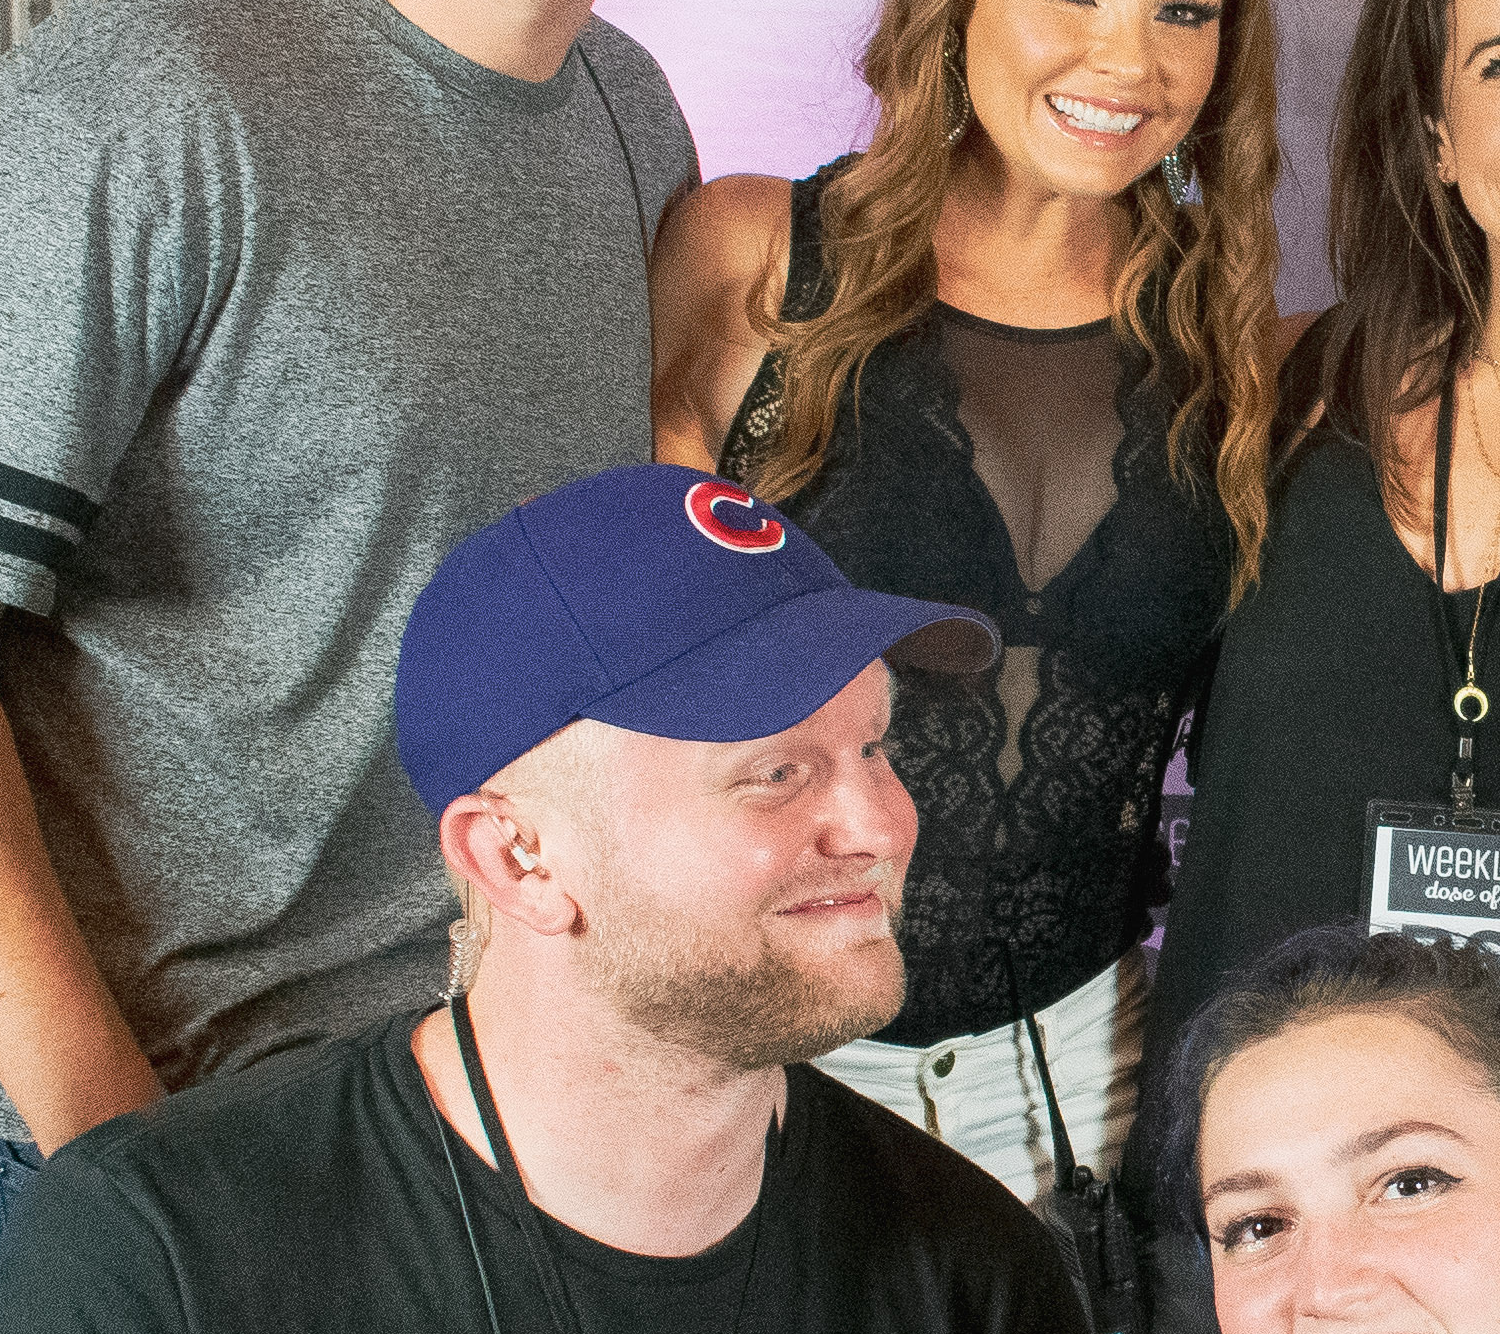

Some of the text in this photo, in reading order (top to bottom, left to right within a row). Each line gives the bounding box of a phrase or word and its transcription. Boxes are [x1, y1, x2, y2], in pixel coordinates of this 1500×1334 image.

[684, 481, 786, 554] C
[1425, 880, 1500, 910] dose of
